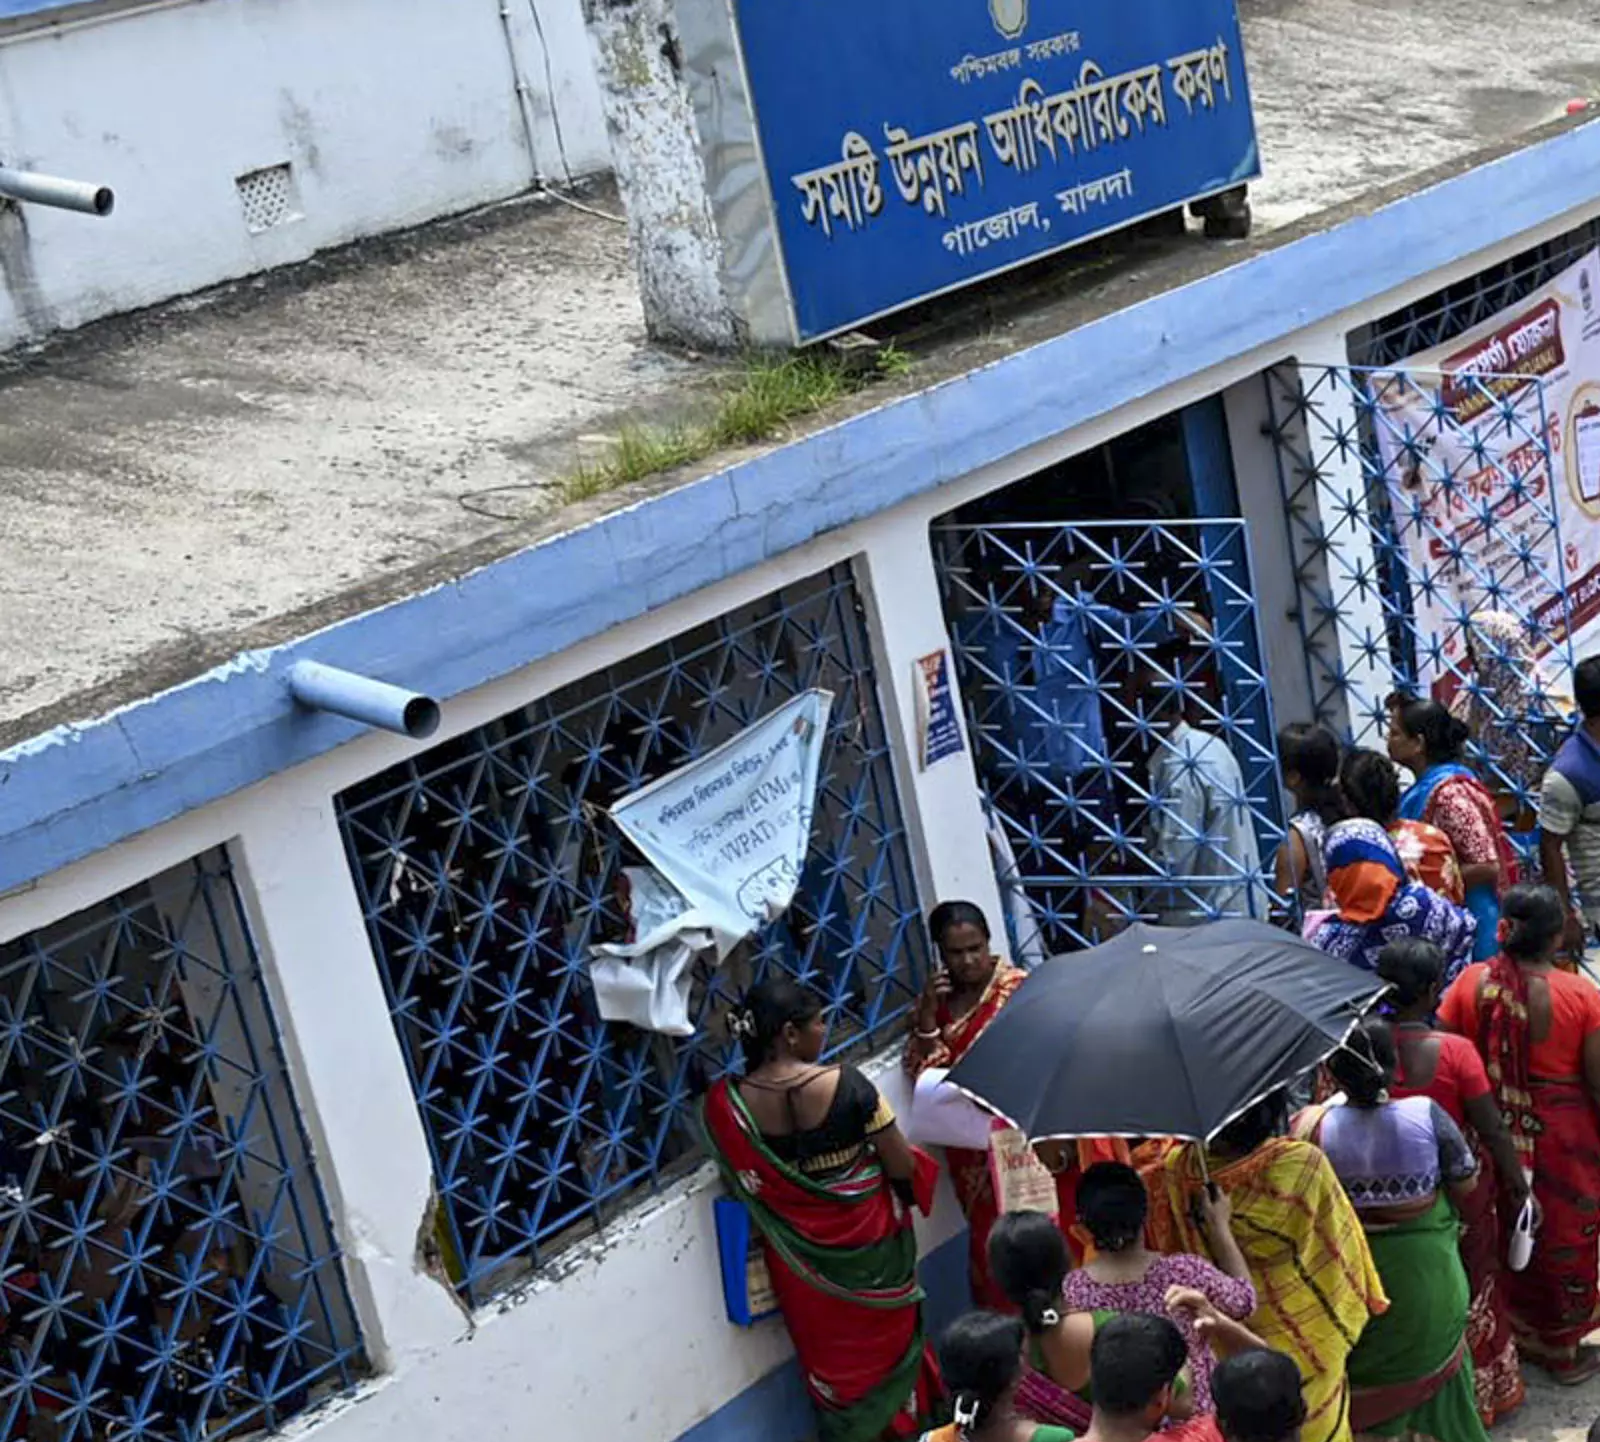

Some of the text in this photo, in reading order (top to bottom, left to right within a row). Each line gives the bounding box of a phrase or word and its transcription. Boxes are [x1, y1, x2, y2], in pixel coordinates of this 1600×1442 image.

[951, 30, 1081, 86] পশ্চিমবঙ্গ সরকার
[792, 131, 883, 237] সমষ্টি
[884, 121, 984, 217] উন্নয়ন
[1167, 36, 1230, 114] করণ
[1055, 167, 1133, 215] মালদা
